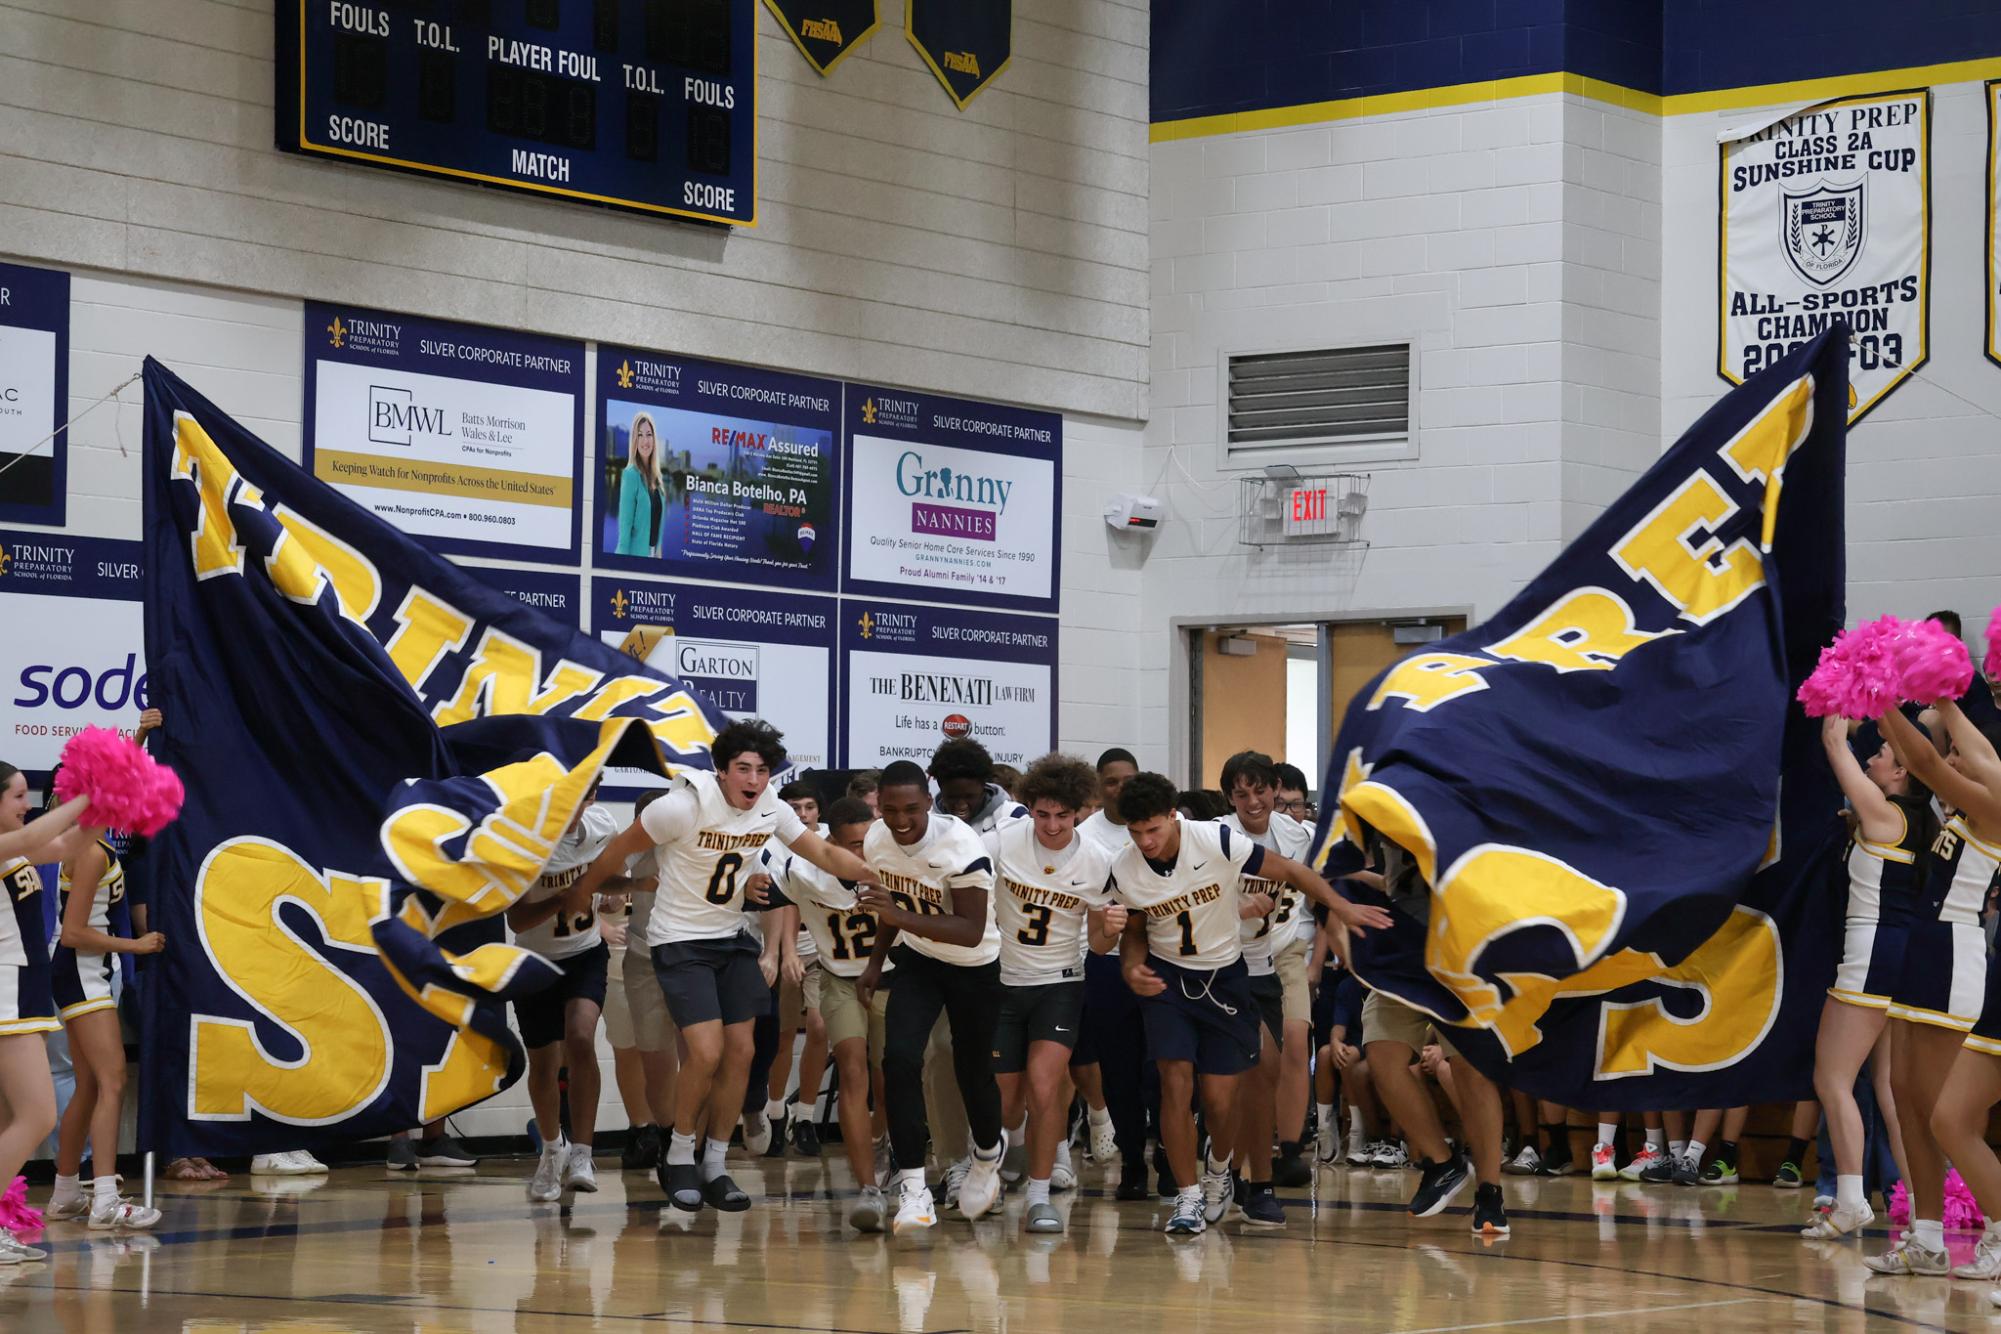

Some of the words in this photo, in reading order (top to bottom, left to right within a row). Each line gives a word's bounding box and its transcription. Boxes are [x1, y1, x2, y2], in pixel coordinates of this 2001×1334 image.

[330, 1, 390, 37] FOULS
[414, 19, 460, 52] T.O.L.
[488, 35, 552, 72] PLAYER
[558, 50, 601, 81] FOUL
[622, 64, 664, 94] T.O.L.
[685, 77, 734, 109] FOULS
[1852, 103, 1917, 130] PREP
[329, 115, 389, 149] SCORE
[1775, 135, 1837, 160] CLASS
[1848, 131, 1873, 151] 2A
[512, 149, 570, 182] MATCH
[1733, 154, 1856, 192] SUNSHINE
[1868, 148, 1916, 172] CUP
[684, 181, 734, 212] SCORE
[1801, 205, 1845, 215] PREPARATORY
[1810, 212, 1837, 220] SCHOOL
[1731, 275, 1917, 316] ALL-SPORTS
[348, 319, 401, 340] TRINITY
[350, 335, 399, 348] PREPARATORY
[420, 339, 455, 358] SILVER
[458, 345, 522, 367] CORPORATE
[524, 353, 571, 374] PARTNER
[635, 360, 681, 380] TRINITY
[636, 376, 679, 388] PREPARATORY
[697, 380, 729, 397] SILVER
[730, 385, 787, 406] CORPORATE
[788, 394, 829, 412] PARTNER
[878, 397, 919, 415] TRINITY
[374, 400, 452, 436] BMWL
[462, 412, 484, 425] Batts
[486, 415, 526, 431] Morrison
[933, 415, 961, 431] SILVER
[962, 419, 1012, 438] CORPORATE
[1014, 428, 1051, 443] PARTNER
[461, 426, 487, 440] Wales
[489, 430, 496, 441] &
[497, 431, 513, 444] Lee
[712, 428, 767, 450] RE/MAX
[768, 436, 819, 458] Assured
[332, 460, 367, 476] Keeping
[369, 464, 395, 477] Watch
[396, 467, 409, 479] for
[411, 469, 455, 485] Nonprofits
[458, 475, 485, 489] Across
[486, 477, 499, 490] the
[501, 478, 528, 493] United
[529, 481, 554, 496] States
[686, 475, 729, 495] Bianca
[732, 481, 786, 504] Botelho,
[789, 489, 807, 505] PA
[374, 503, 461, 520] www.NonprofitCPA.com
[469, 512, 516, 526] 800.960.0803
[1293, 489, 1327, 521] EXIT
[916, 509, 993, 535] NANNIES
[12, 545, 75, 564] TRINITY
[870, 536, 897, 549] Quality
[899, 539, 921, 550] Senior
[924, 542, 944, 552] Home
[946, 544, 964, 555] Care
[965, 546, 995, 558] Services
[997, 550, 1016, 560] Since
[1018, 552, 1036, 562] 1990
[915, 554, 991, 568] GRANNYNANNIES.COM
[14, 562, 72, 573] PREPARATORY
[14, 571, 37, 579] SCHOOL
[46, 573, 72, 581] FLORIDA
[97, 561, 138, 579] SILVER
[900, 566, 922, 577] Proud
[924, 568, 949, 580] Alumni
[951, 571, 975, 584] Family
[989, 575, 994, 584] &
[518, 591, 566, 608] PARTNER
[629, 590, 676, 607] TRINITY
[630, 605, 674, 615] PREPARATORY
[693, 605, 724, 621] SILVER
[726, 607, 782, 625] CORPORATE
[784, 613, 826, 629] PARTNER
[875, 612, 917, 628] TRINITY
[932, 625, 959, 641] SILVER
[961, 628, 1010, 645] CORPORATE
[1012, 633, 1048, 647] PARTNER
[679, 646, 753, 676] GARTON
[869, 677, 897, 695] THE
[900, 673, 992, 705] BENENATI
[995, 685, 1013, 701] LAW
[1014, 686, 1035, 703] FIRM
[15, 724, 48, 736] FOOD
[895, 715, 912, 729] Life
[915, 716, 930, 730] has
[932, 721, 938, 730] a
[994, 752, 1023, 764] INJURY
[698, 831, 745, 851] TRINITY
[706, 852, 743, 905] 0
[879, 869, 918, 896] TRINITY
[919, 882, 942, 904] PREP
[1004, 877, 1050, 905] TRINITY
[1049, 891, 1080, 910] PREP
[1143, 895, 1191, 919] TRINITY
[1192, 883, 1221, 905] PREP
[828, 911, 879, 960] 12
[1016, 903, 1053, 947] 3
[1176, 910, 1199, 956] 1
